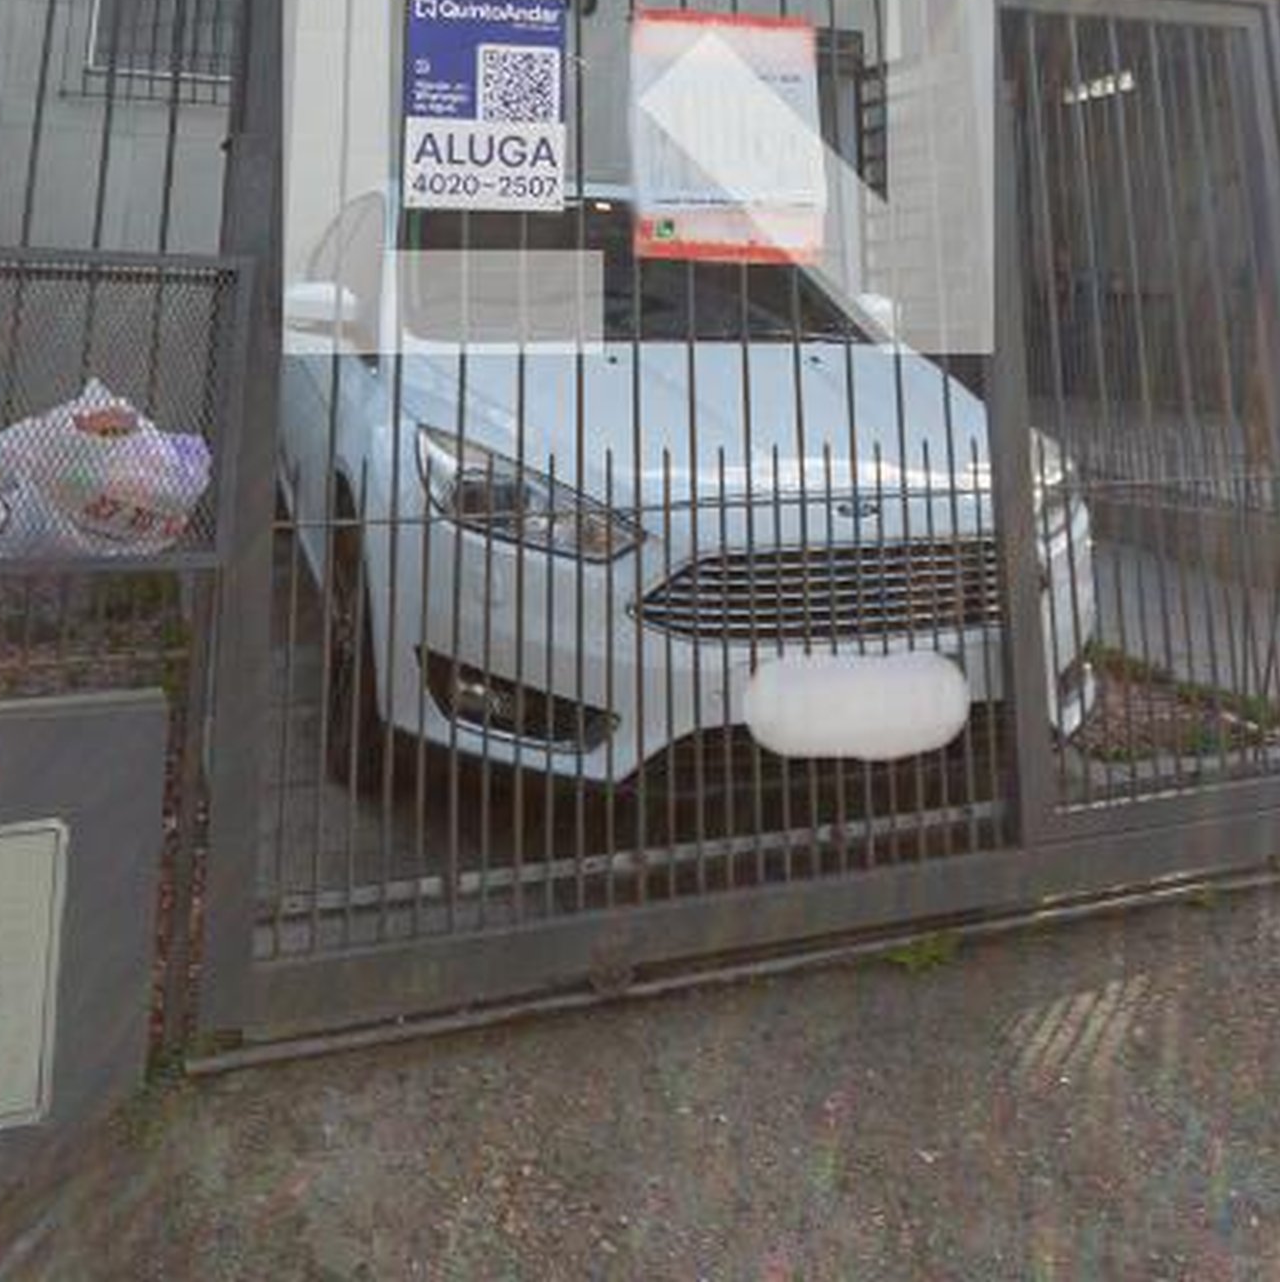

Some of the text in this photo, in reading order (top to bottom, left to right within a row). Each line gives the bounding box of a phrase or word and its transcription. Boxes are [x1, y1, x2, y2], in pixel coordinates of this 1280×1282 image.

[438, 0, 559, 24] QuintoAndar
[413, 132, 557, 168] ALUGA
[412, 172, 558, 197] 4020-2507
